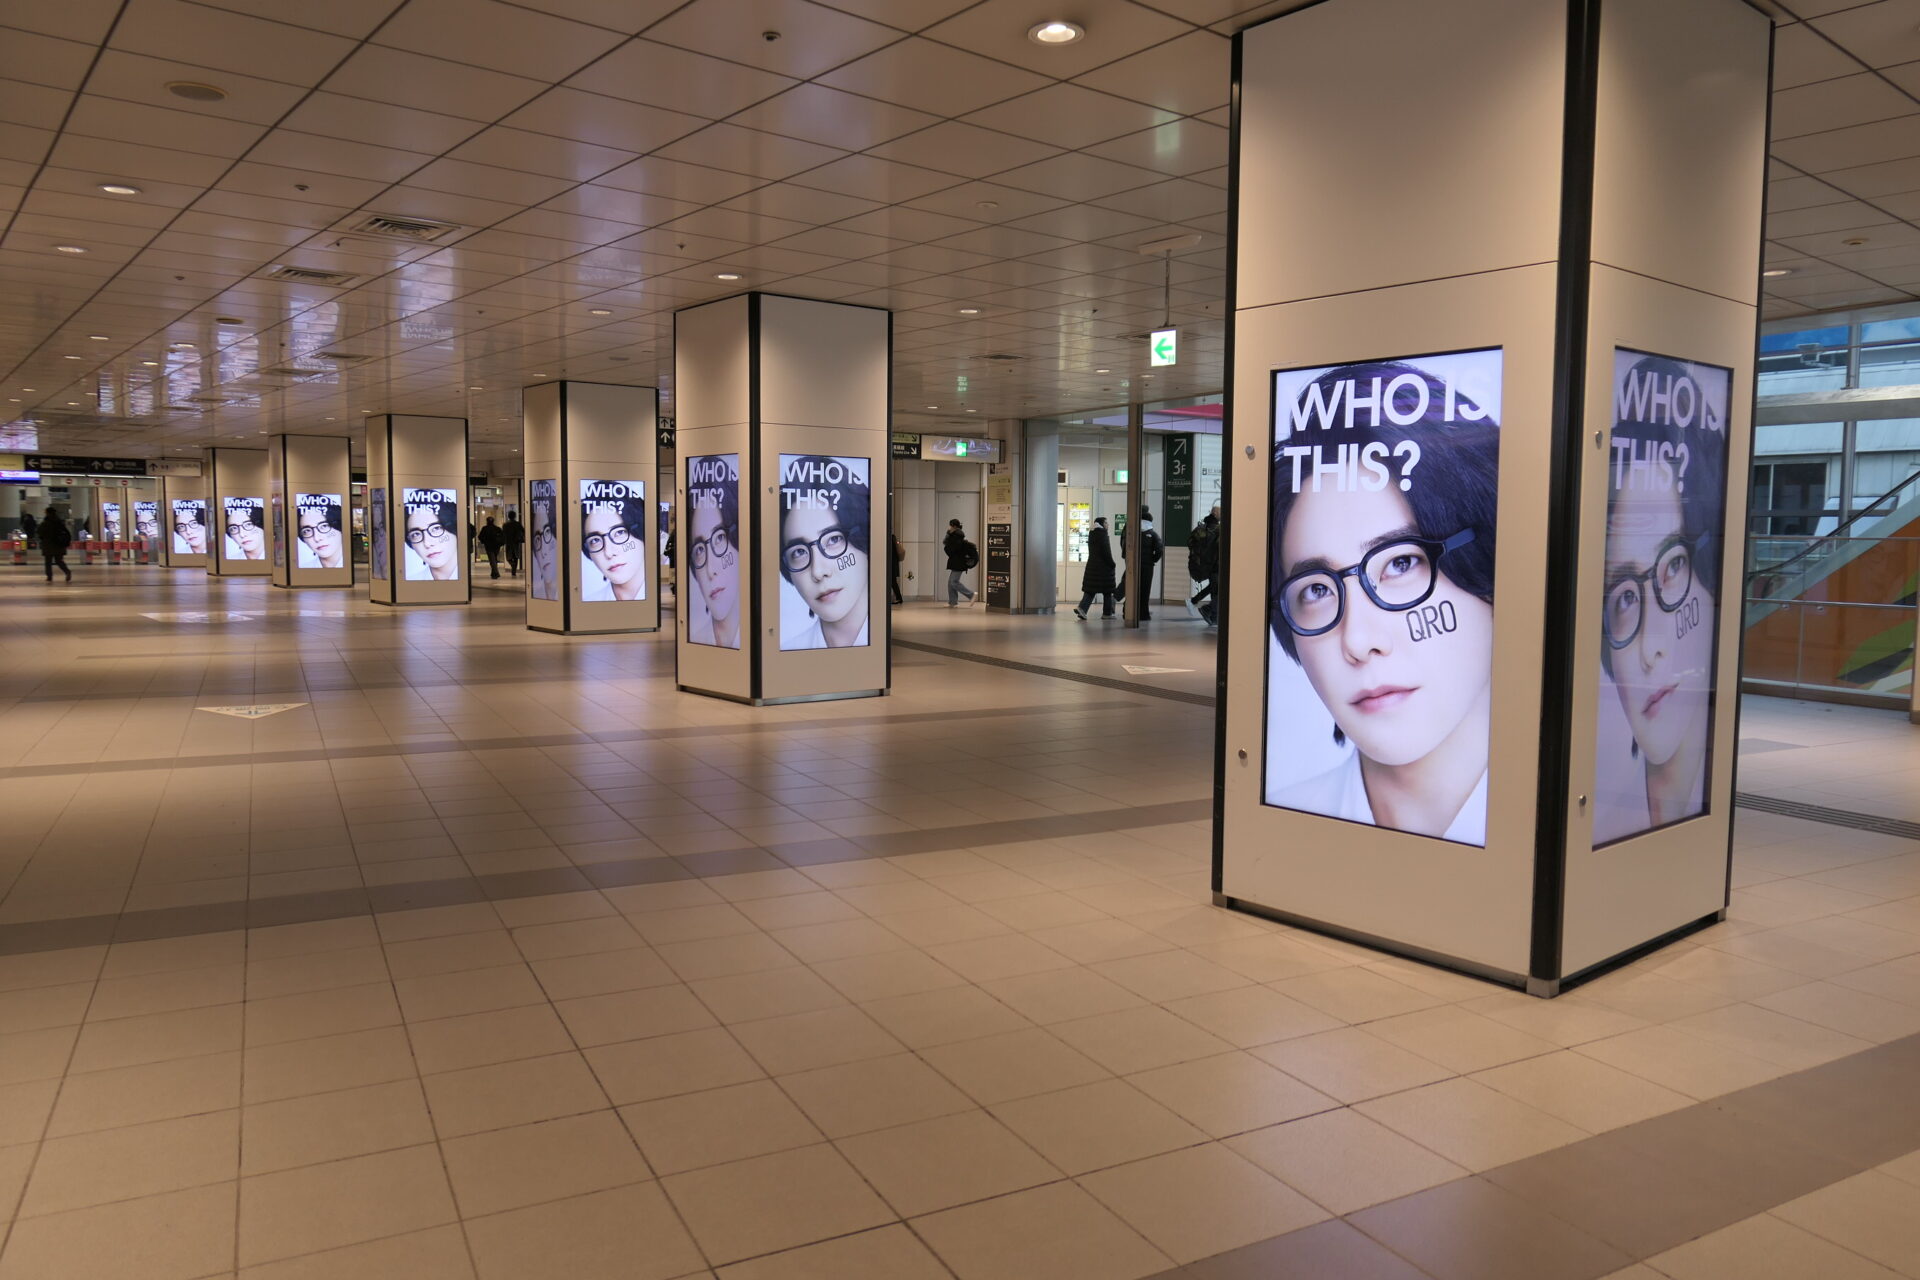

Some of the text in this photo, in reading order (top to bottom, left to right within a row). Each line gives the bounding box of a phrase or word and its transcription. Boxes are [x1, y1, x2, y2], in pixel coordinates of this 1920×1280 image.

[1287, 373, 1430, 432] WHO
[1616, 368, 1695, 428] WHO
[691, 460, 726, 483] WHO
[784, 461, 843, 484] WHO
[1283, 439, 1422, 494] THIS?
[1611, 436, 1690, 494] THIS?
[300, 496, 329, 505] WHO
[407, 491, 442, 503] WHO
[584, 483, 626, 498] WHO
[690, 487, 725, 510] THIS?
[782, 488, 841, 511] THIS?
[406, 504, 440, 515] THIS?
[583, 500, 625, 515] THIS?
[836, 552, 857, 571] QRO
[1405, 599, 1458, 643] QRO
[1674, 596, 1700, 640] QRO
